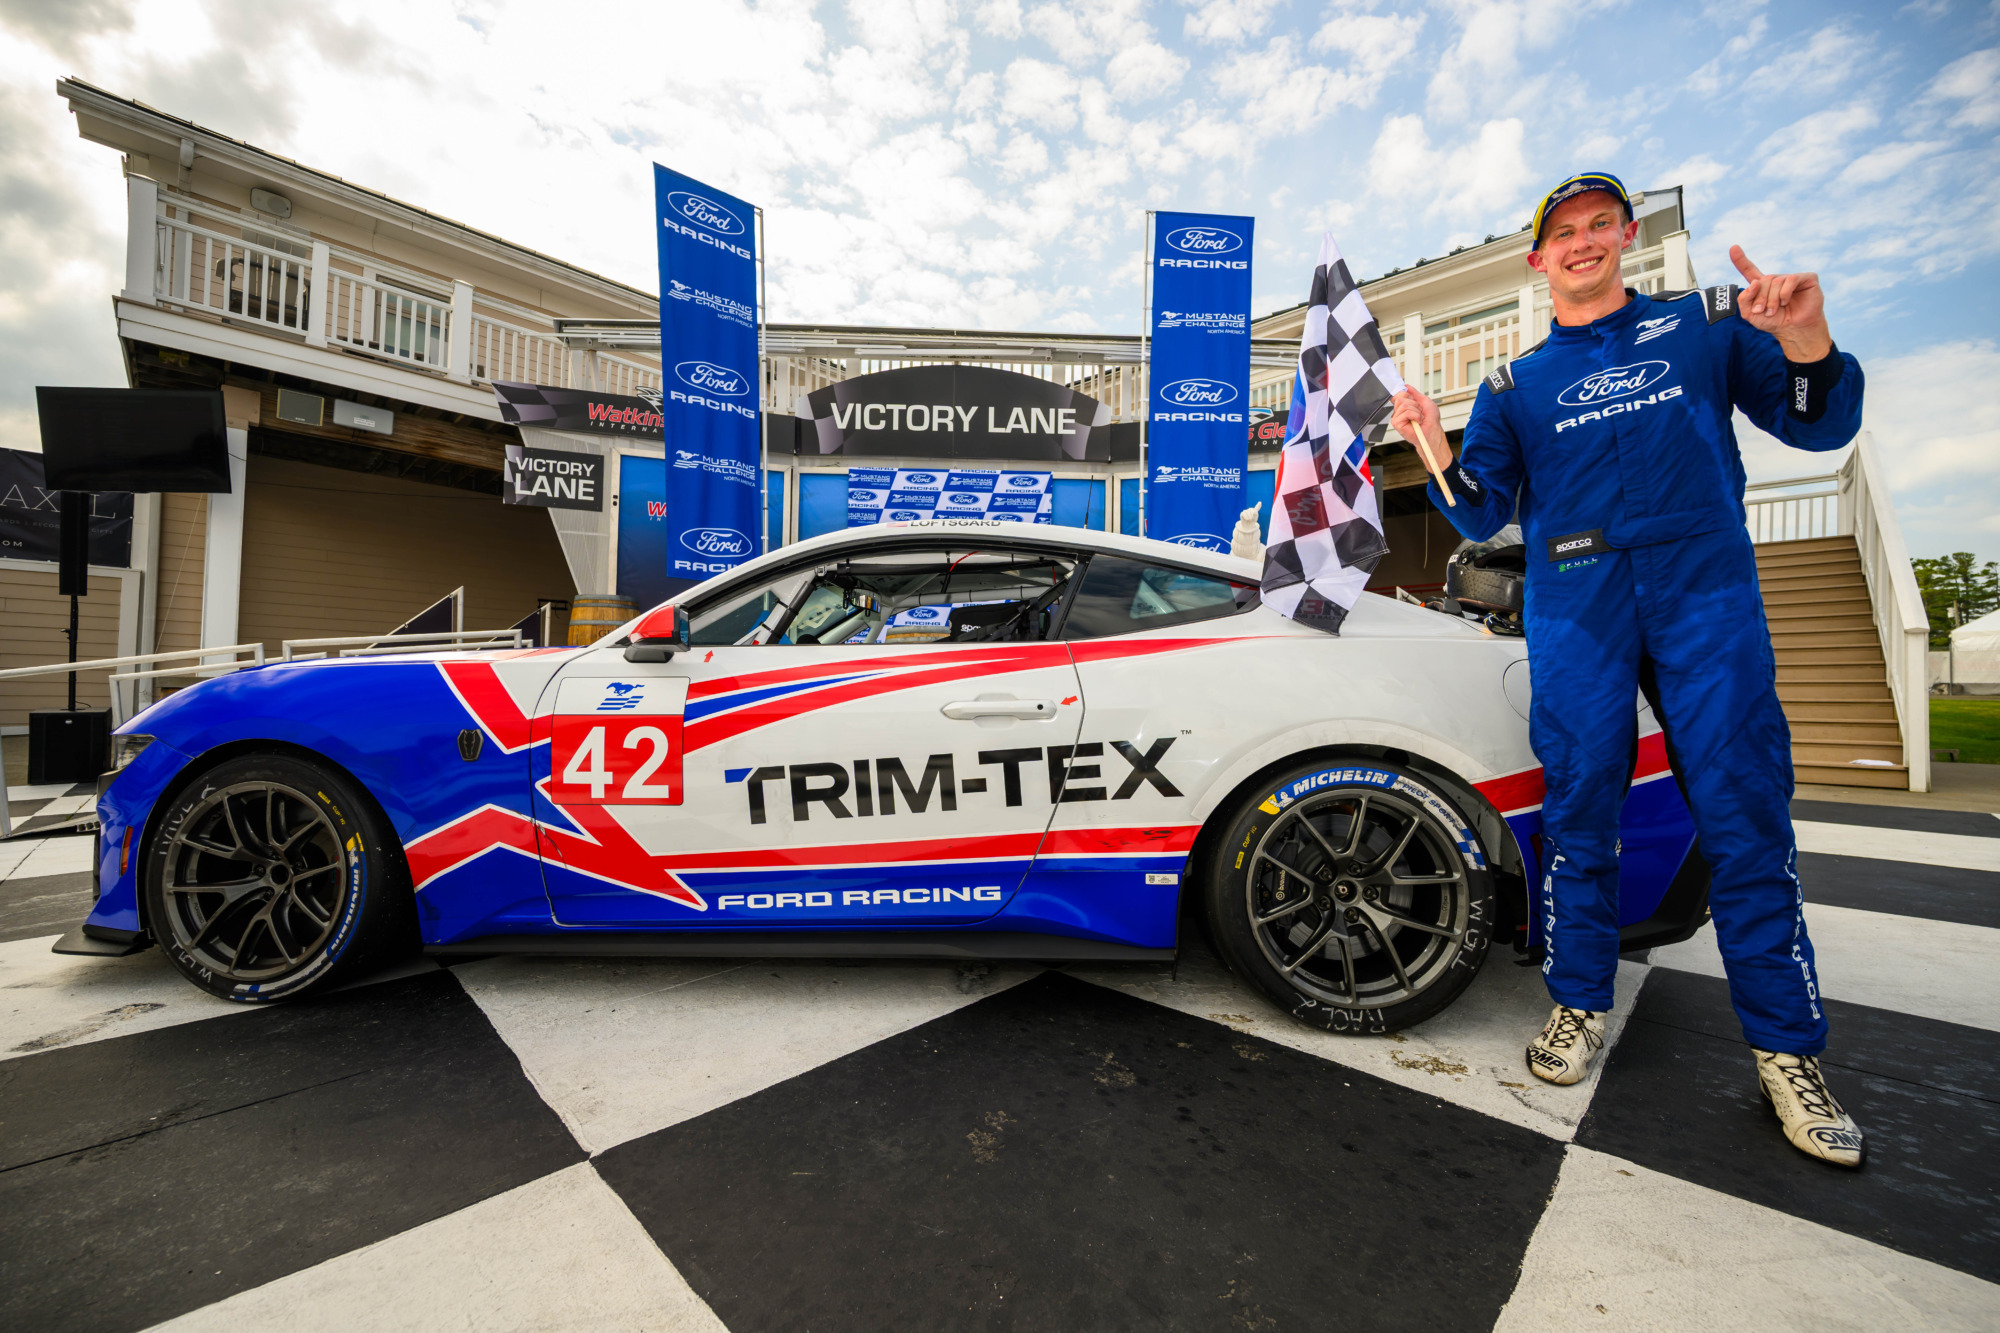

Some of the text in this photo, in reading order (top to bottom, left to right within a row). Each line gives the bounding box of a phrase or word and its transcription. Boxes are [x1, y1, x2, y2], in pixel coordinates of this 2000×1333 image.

[683, 197, 730, 231] Ford
[664, 217, 751, 260] RACING
[1180, 230, 1228, 250] Ford
[1159, 258, 1248, 270] RACING
[694, 288, 753, 315] MUSTANG
[695, 298, 753, 322] CHALLENGE
[717, 313, 754, 329] NORTH AMERICA
[690, 364, 738, 393] Ford
[1578, 368, 1647, 401] Ford
[1174, 381, 1223, 403] Ford
[1794, 376, 1808, 413] sparco
[670, 390, 755, 419] RACING
[1555, 385, 1683, 433] RACING
[830, 402, 1077, 435] VICTORY LANE
[1154, 412, 1243, 423] RACING
[1258, 422, 1288, 440] Gle
[515, 456, 595, 477] VICTORY
[702, 455, 756, 473] MUSTANG
[702, 464, 756, 481] CHALLENGE
[1181, 467, 1241, 475] MUSTANG
[515, 472, 595, 501] LANE
[739, 477, 756, 488] AMERICA
[910, 473, 931, 483] Ford
[1013, 476, 1033, 486] Ford
[0, 484, 116, 519] AXL
[851, 491, 871, 501] Ford
[954, 493, 974, 503] Ford
[895, 512, 916, 521] Ford
[910, 519, 1001, 527] LOFTSGARD
[696, 530, 742, 554] Ford
[1556, 537, 1592, 553] sparco
[674, 559, 738, 573] RACI
[912, 609, 933, 619] Ford
[563, 725, 670, 800] 42
[724, 736, 1186, 825] TRIM-TEX
[1292, 769, 1390, 796] MICHELIN
[1402, 782, 1457, 824] PILOT SPORT
[717, 886, 1002, 911] FORD RACING
[1542, 836, 1565, 976] USTANG
[1530, 1049, 1564, 1068] OMP
